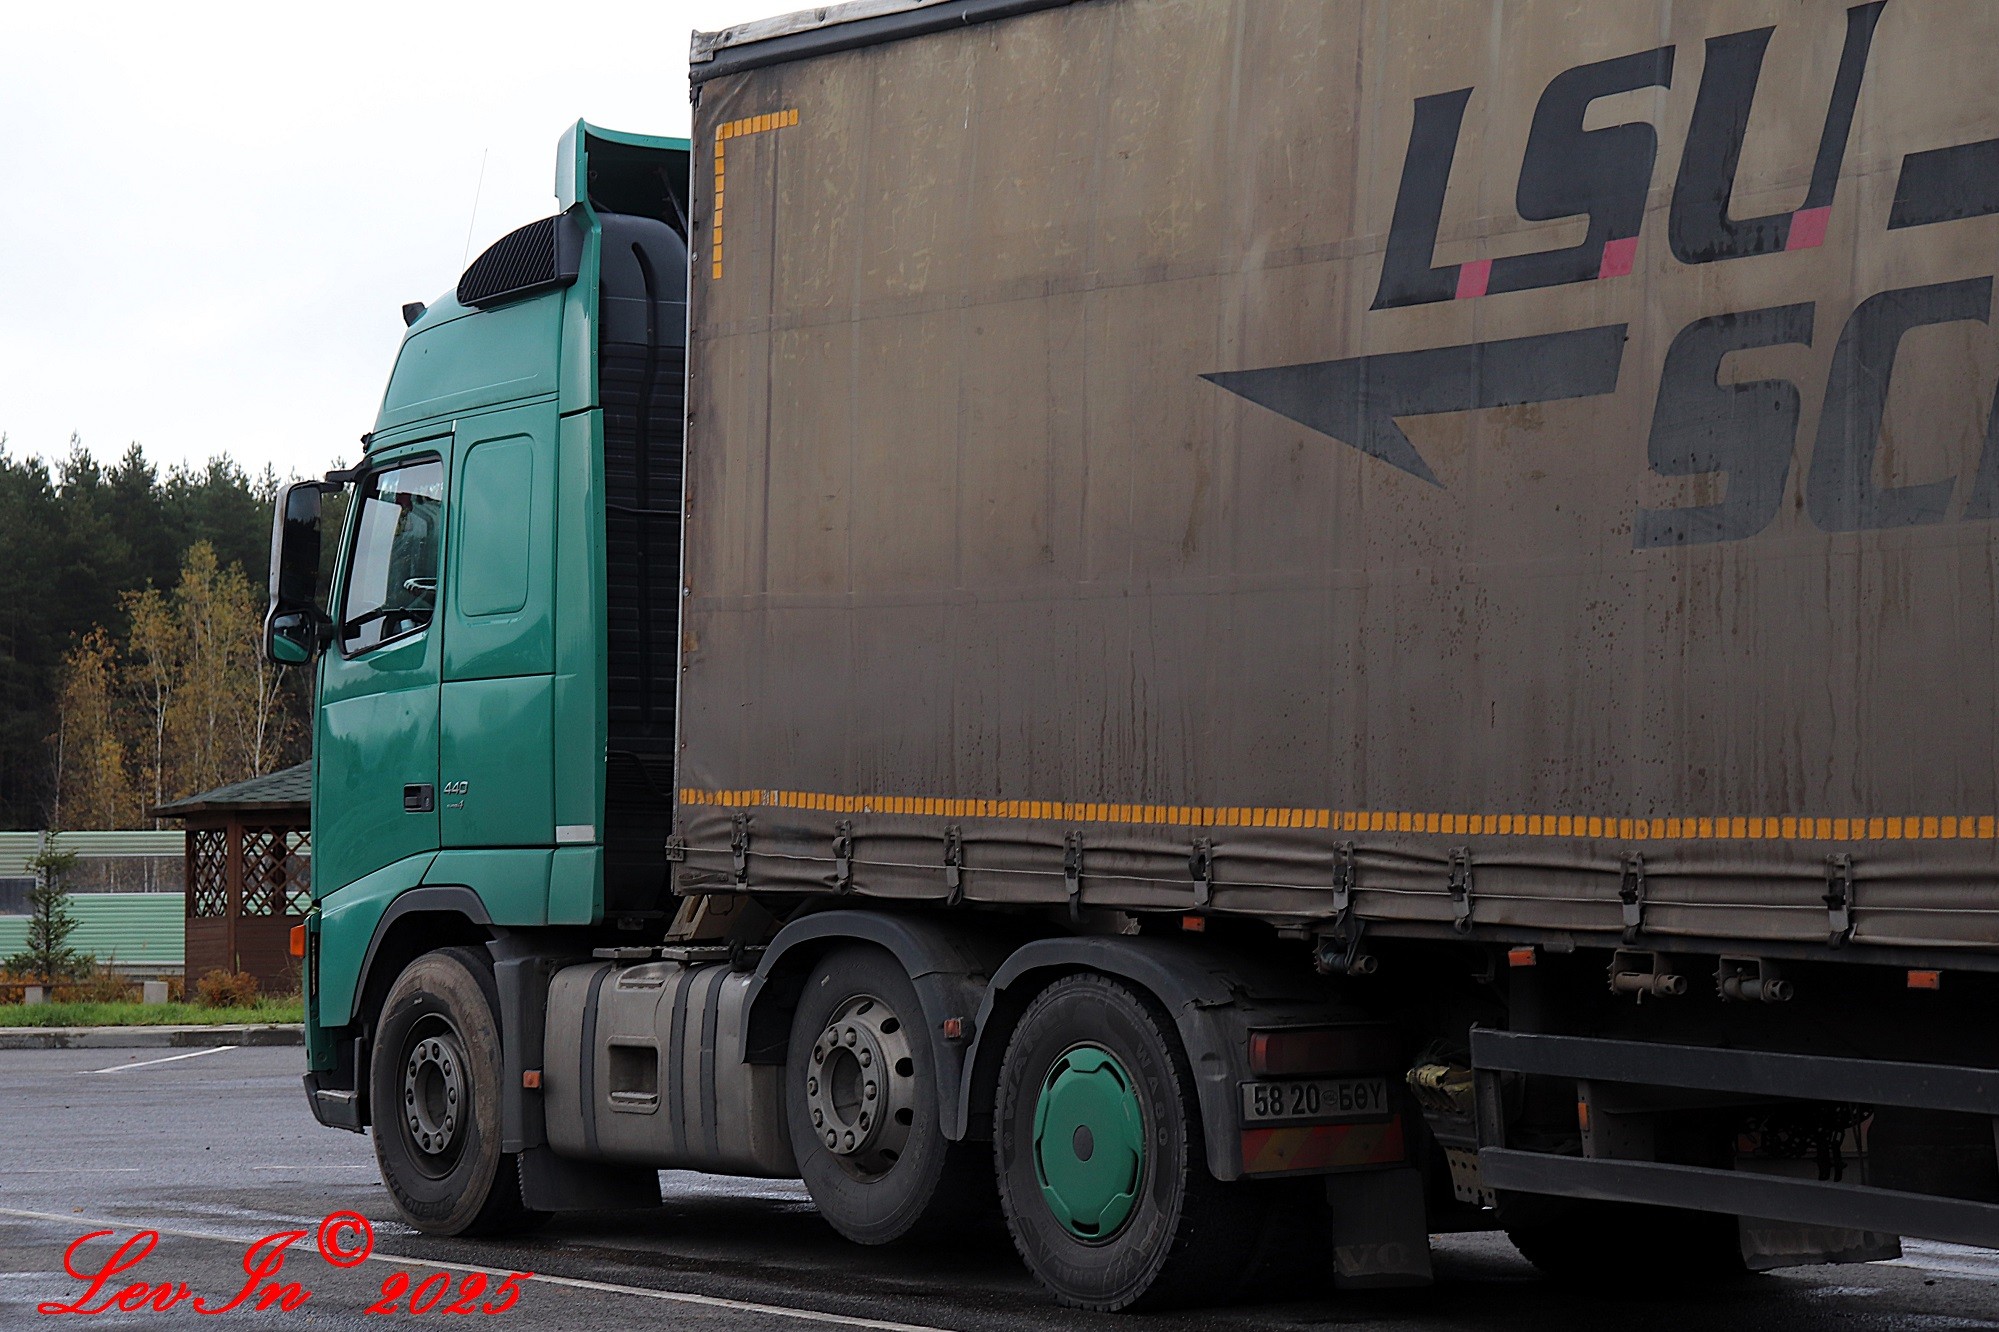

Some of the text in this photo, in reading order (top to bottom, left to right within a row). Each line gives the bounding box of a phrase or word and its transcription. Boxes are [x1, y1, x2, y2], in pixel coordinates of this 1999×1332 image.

[1369, 0, 1888, 311] LSU
[1633, 276, 1999, 550] SC
[443, 780, 469, 795] 440
[1254, 1084, 1285, 1117] 58
[1290, 1083, 1321, 1115] 20
